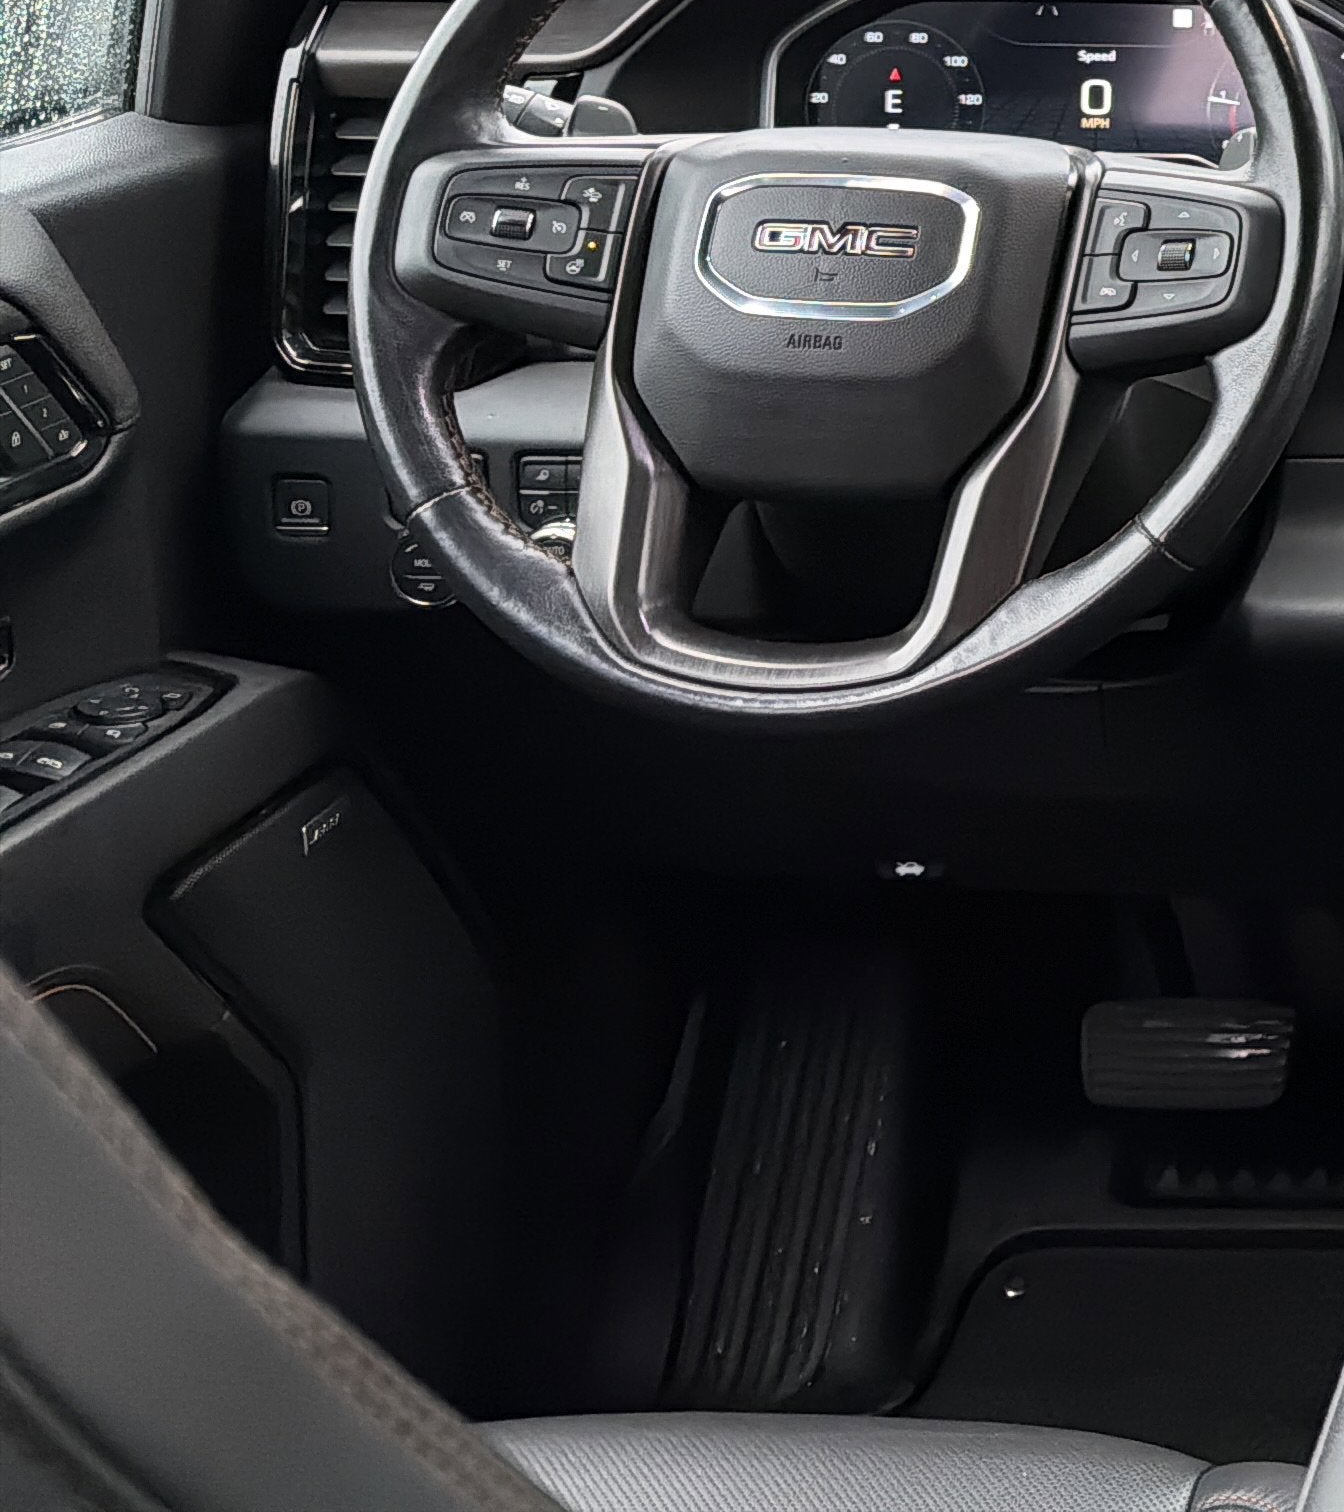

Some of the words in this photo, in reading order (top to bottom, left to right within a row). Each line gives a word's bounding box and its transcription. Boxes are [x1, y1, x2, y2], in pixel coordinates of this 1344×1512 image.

[826, 53, 847, 65] 40
[943, 55, 969, 67] 100
[1077, 49, 1117, 64] Speed
[809, 92, 829, 103] 20
[884, 89, 903, 113] E
[957, 93, 983, 105] 120
[1080, 78, 1112, 116] 0
[1080, 117, 1110, 129] MPH
[752, 219, 921, 259] GMC
[496, 259, 512, 268] SET
[786, 333, 843, 351] AIRBAG
